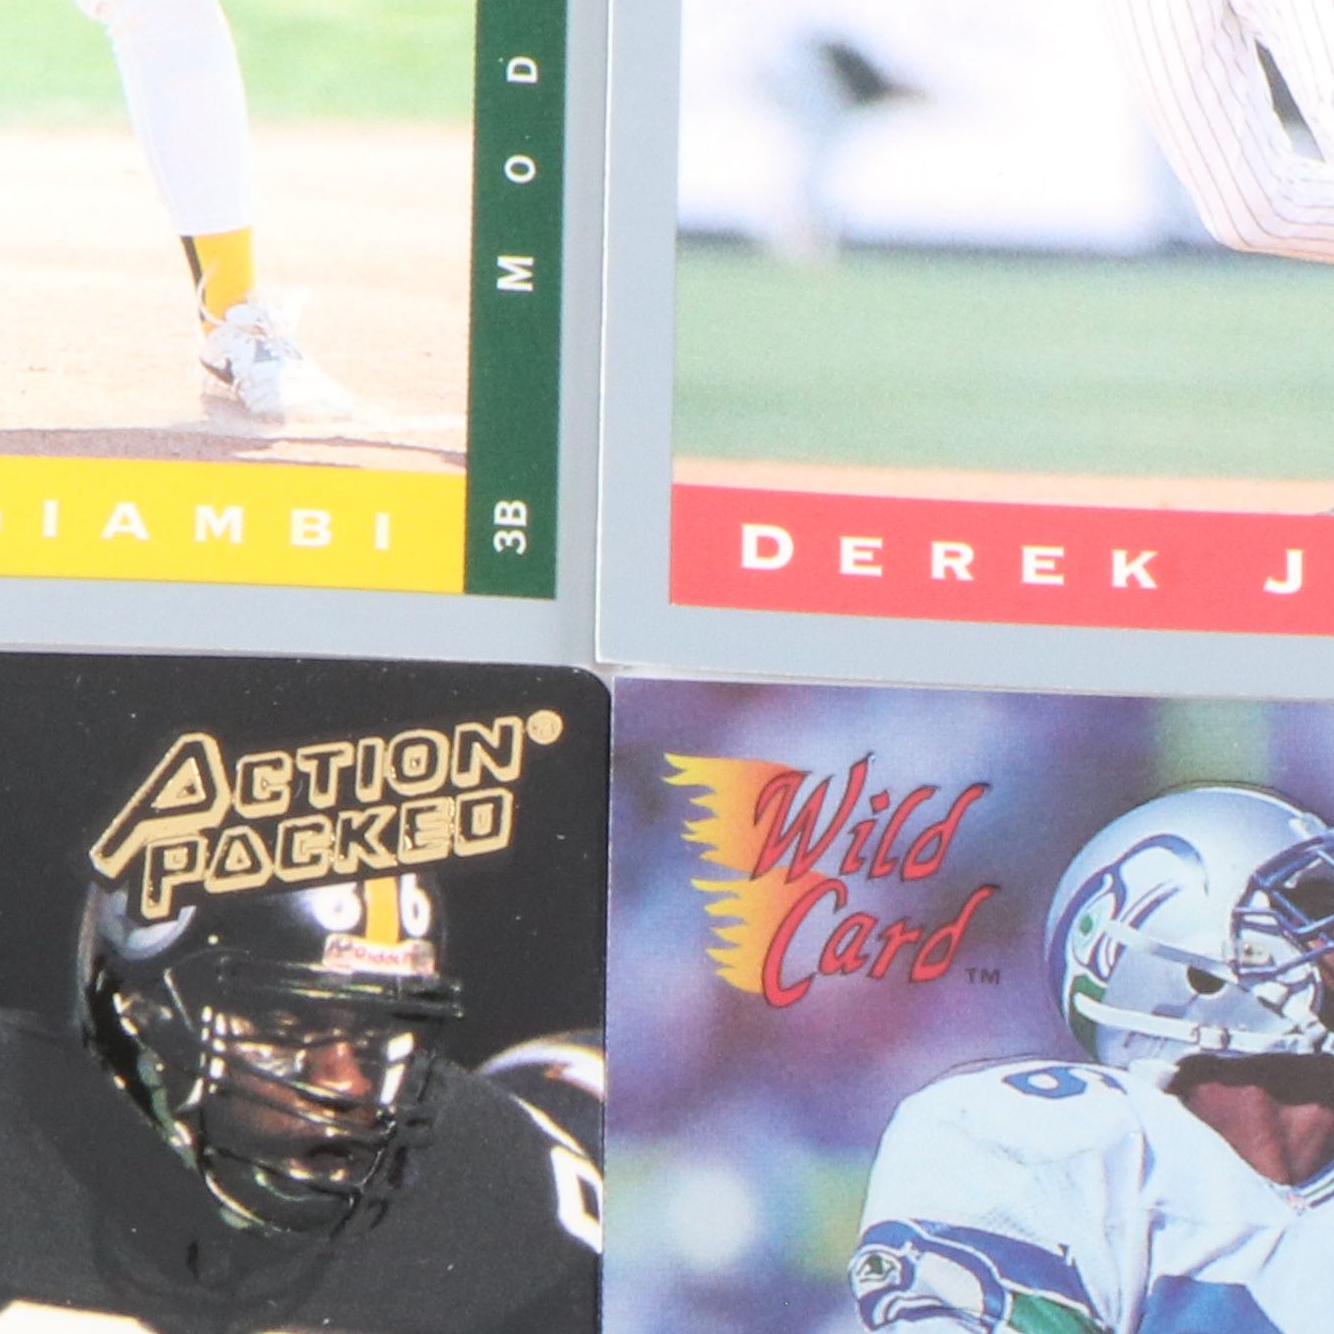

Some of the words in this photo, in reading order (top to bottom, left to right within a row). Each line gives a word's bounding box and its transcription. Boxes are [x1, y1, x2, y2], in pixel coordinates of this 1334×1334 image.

[493, 499, 528, 555] 3B
[741, 523, 1158, 590] DEREK
[749, 753, 992, 885] Wild
[762, 878, 1001, 1008] Card
